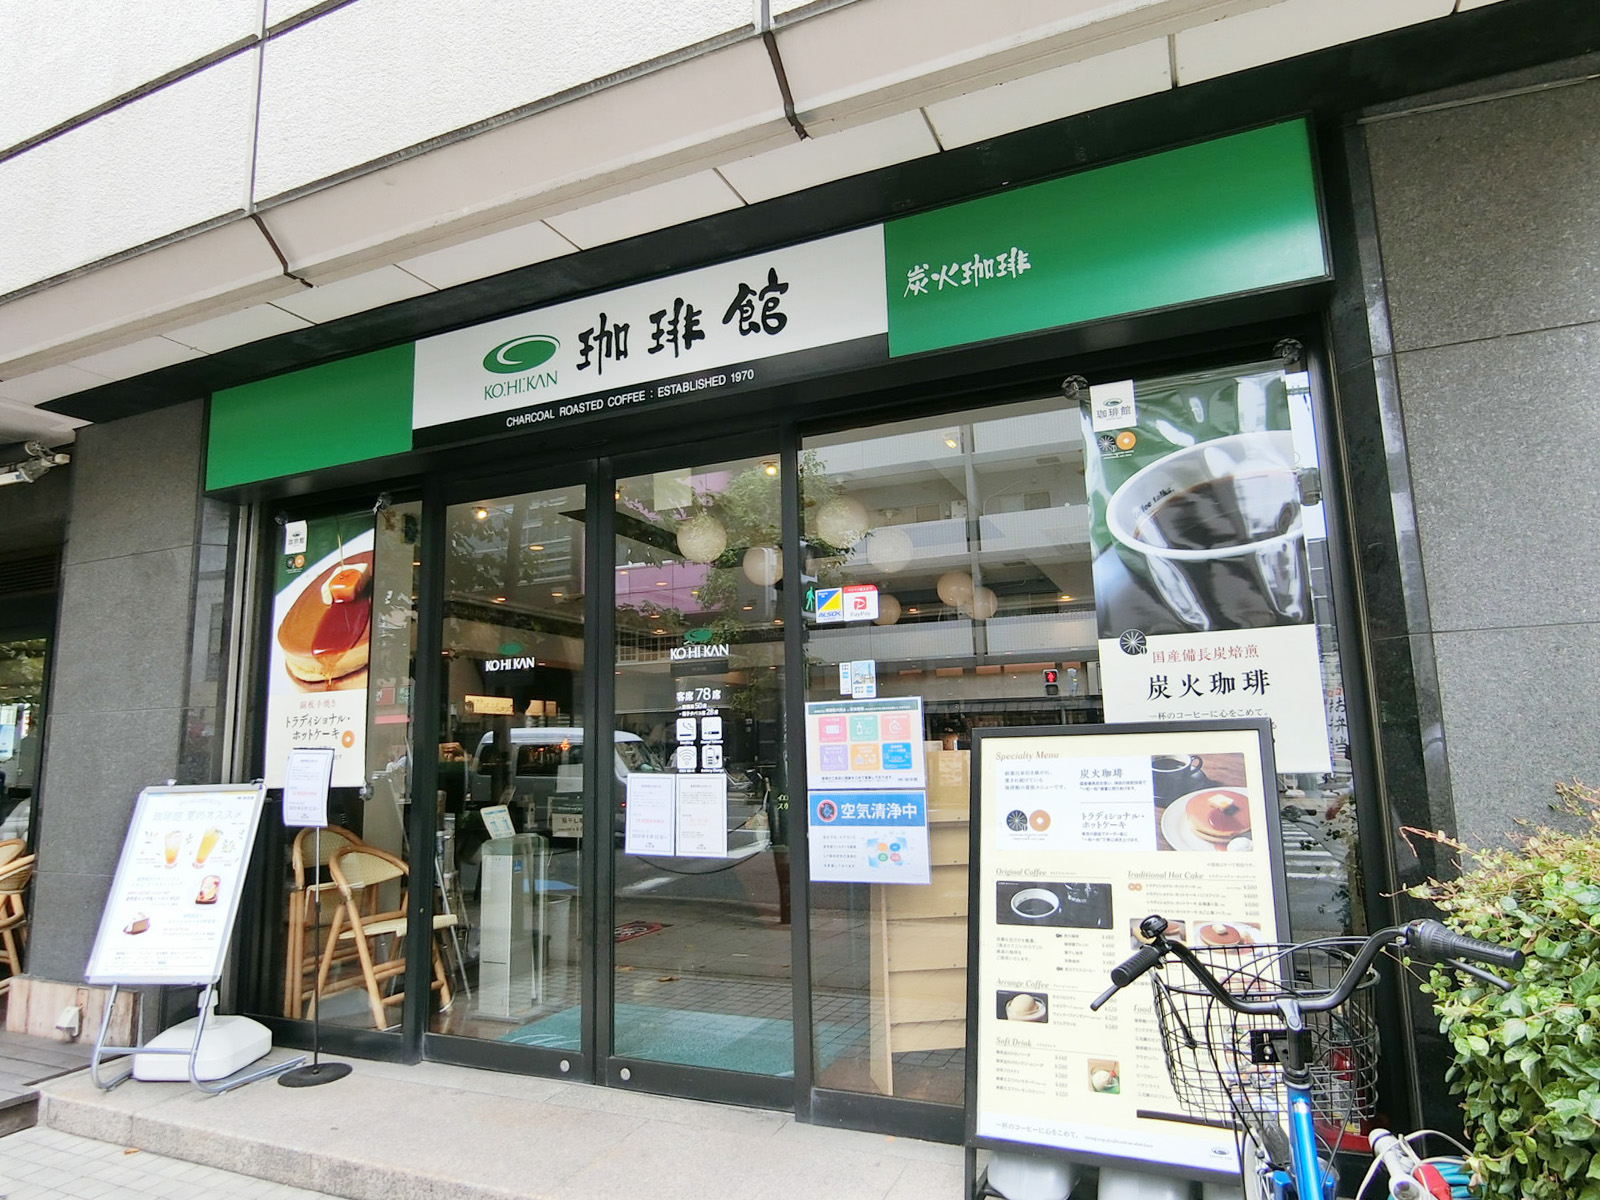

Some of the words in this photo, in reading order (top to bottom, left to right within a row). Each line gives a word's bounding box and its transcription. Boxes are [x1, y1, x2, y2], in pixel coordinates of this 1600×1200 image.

[904, 246, 1032, 298] 炭火珈琲
[576, 267, 789, 375] 珈琲館
[505, 408, 555, 428] CHARCOAL
[559, 399, 604, 418] ROASTED
[607, 390, 646, 408] COFFEE
[657, 374, 727, 398] ESTABLISHED
[730, 369, 755, 384] 1970
[1152, 644, 1260, 664] 国産備長炭焙煎
[1146, 668, 1271, 701] 炭火珈琲
[1150, 708, 1269, 720] 一杯のコーヒーに心をこめて。
[293, 728, 340, 741] ホットケーキ
[995, 751, 1033, 762] Specialty
[1036, 750, 1060, 759] Menu
[1079, 768, 1124, 779] 炭火珈琲
[841, 803, 918, 819] 空気清浄中
[1082, 820, 1127, 830] ホットケーキ
[996, 868, 1023, 878] Original
[1024, 868, 1048, 878] Coffee
[1128, 870, 1166, 879] Traditional
[1168, 871, 1182, 879] Hot
[1184, 871, 1204, 879] Cake
[1025, 978, 1050, 989] Coffee
[1133, 1004, 1152, 1013] Food
[996, 1037, 1011, 1047] Soft
[1012, 1038, 1032, 1047] Drink
[995, 1121, 1079, 1139] 一杯のコーヒーに心をこめて。
